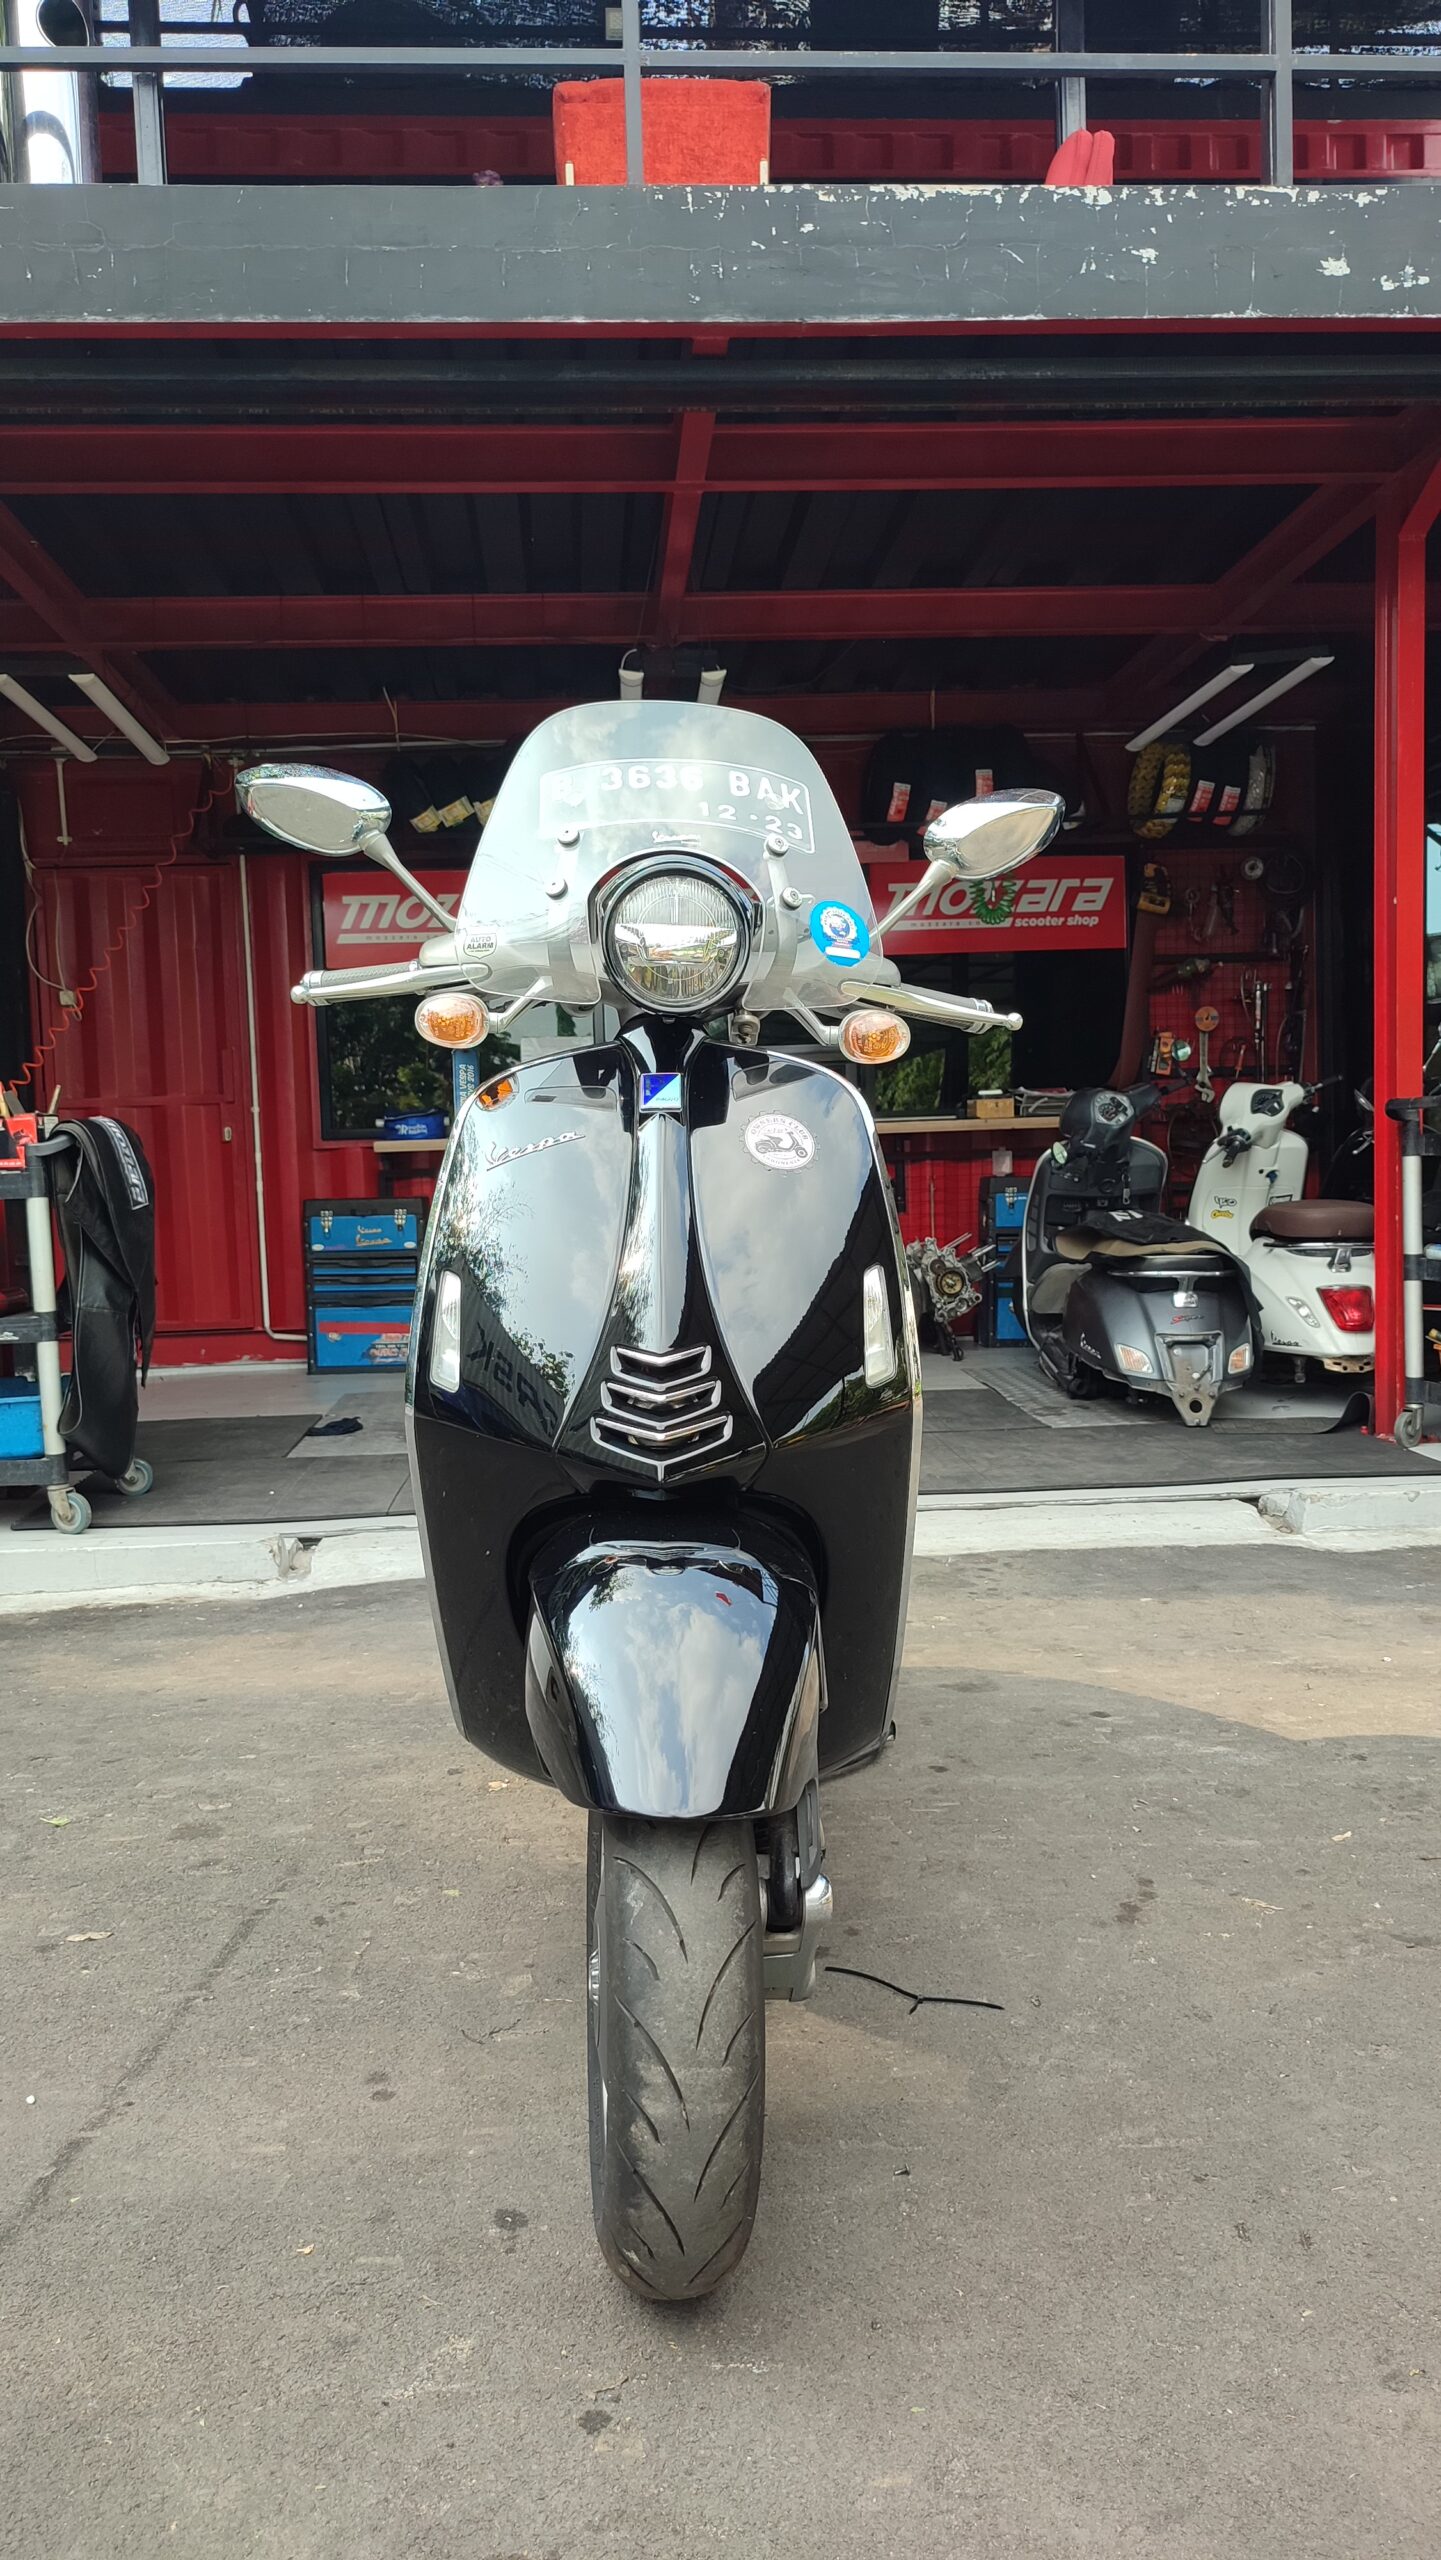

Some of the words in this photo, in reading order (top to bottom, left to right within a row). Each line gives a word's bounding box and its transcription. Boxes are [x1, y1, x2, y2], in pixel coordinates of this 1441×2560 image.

[550, 775, 574, 796] B
[600, 765, 704, 791] 3636
[728, 770, 804, 814] BAK
[1014, 917, 1064, 928] scooter
[1066, 914, 1099, 927] shop
[466, 942, 494, 950] ALARM
[458, 1063, 467, 1089] VESPA
[788, 1120, 809, 1140] CLUB
